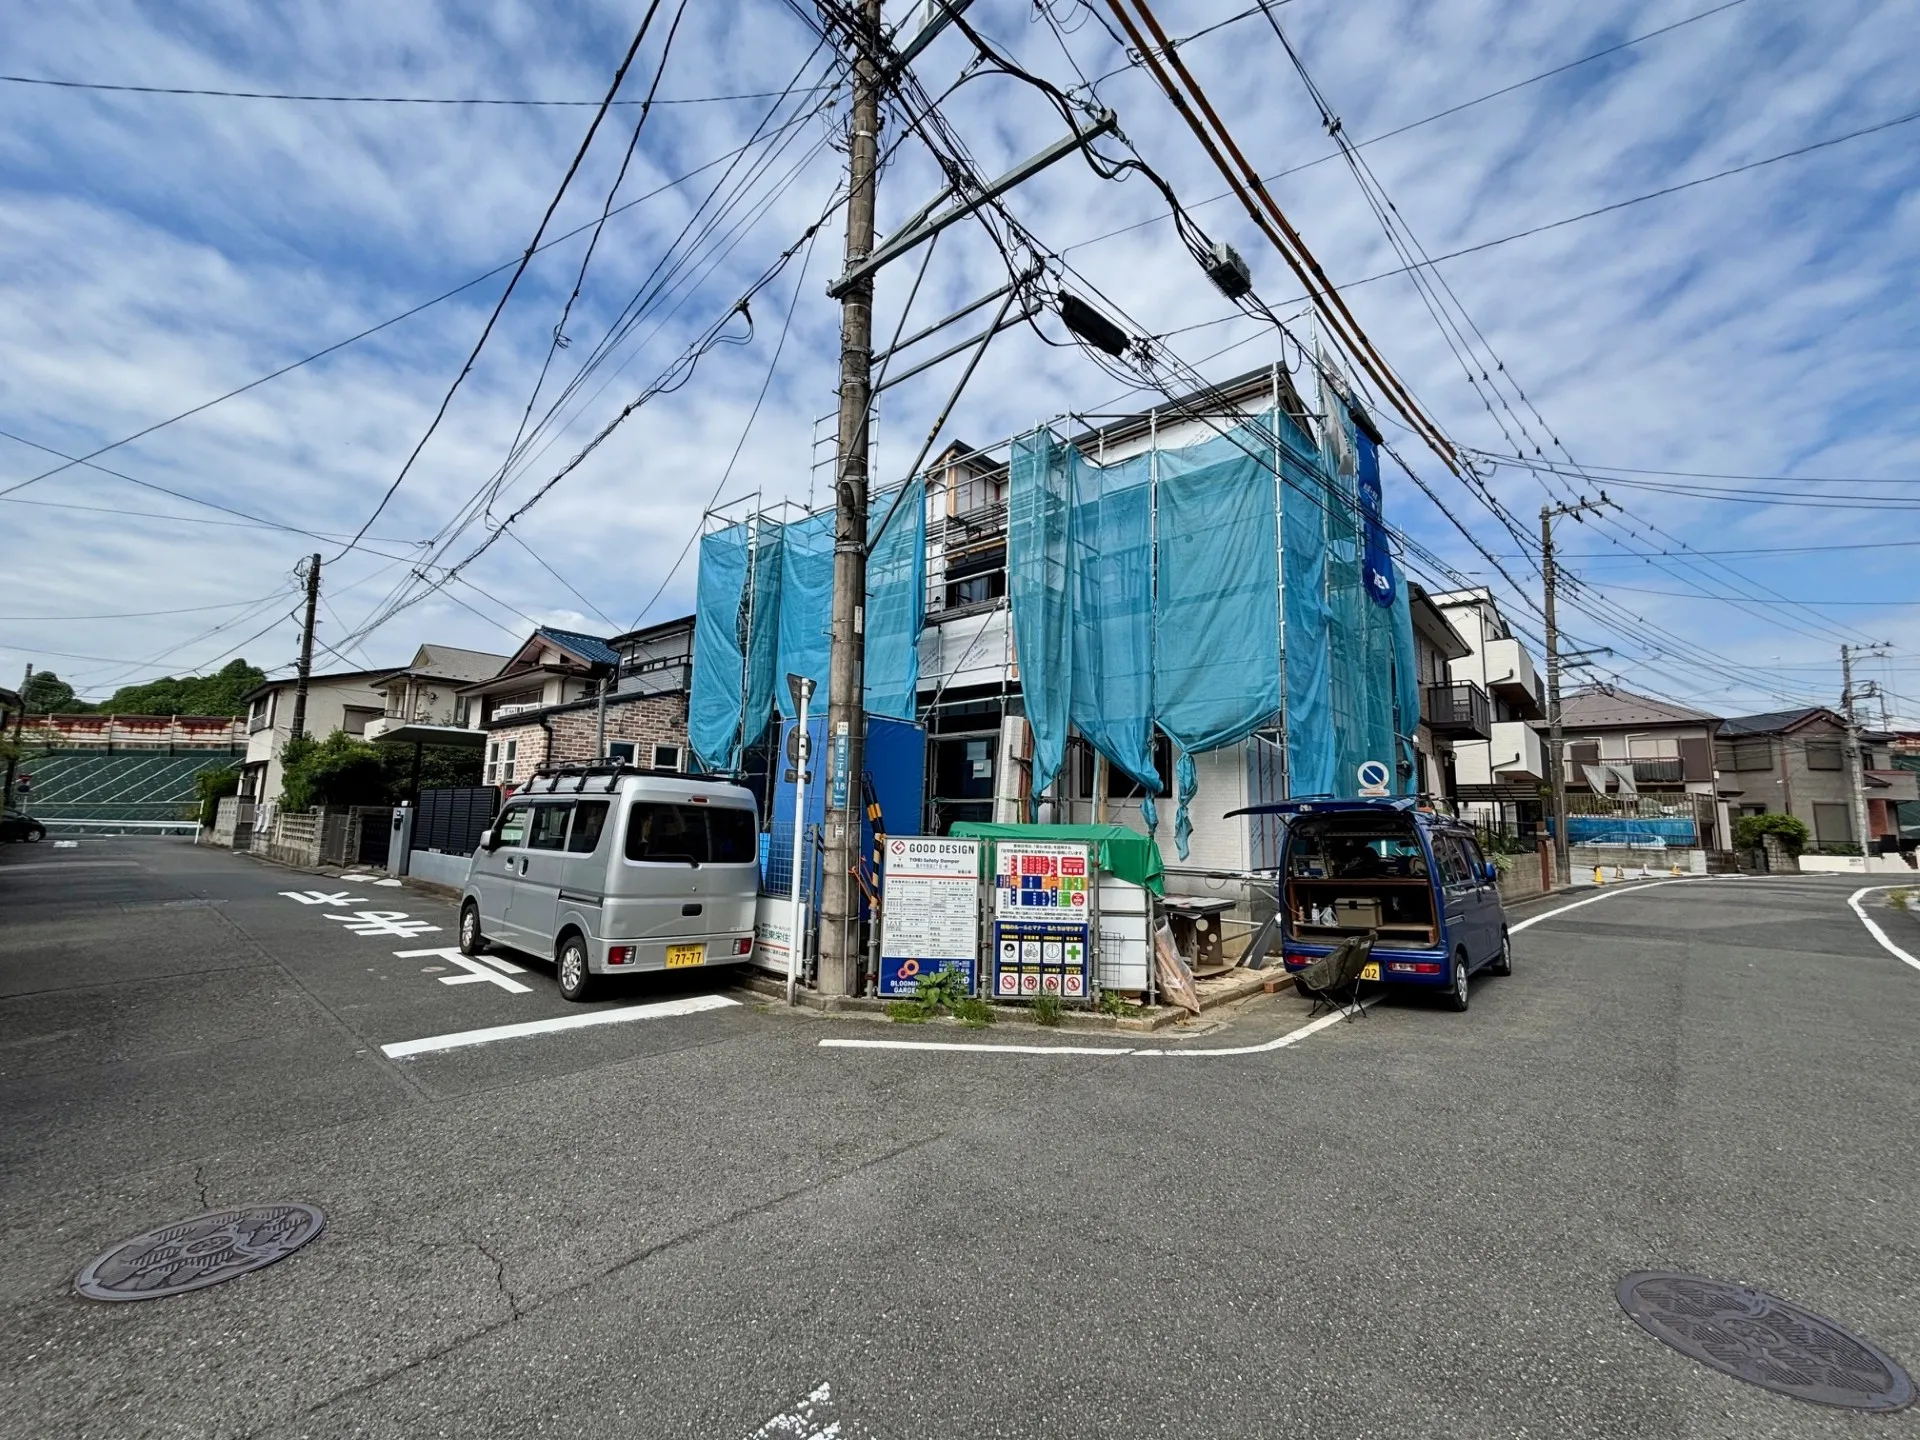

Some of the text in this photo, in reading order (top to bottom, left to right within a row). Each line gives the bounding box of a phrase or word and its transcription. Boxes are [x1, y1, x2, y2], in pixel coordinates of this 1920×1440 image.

[835, 782, 845, 791] 18
[909, 843, 975, 855] GOOD DESIGN
[278, 890, 534, 994] 止まれ
[768, 930, 792, 943] 東栄住
[675, 952, 701, 966] 77-77
[890, 980, 920, 988] BLOOMIN
